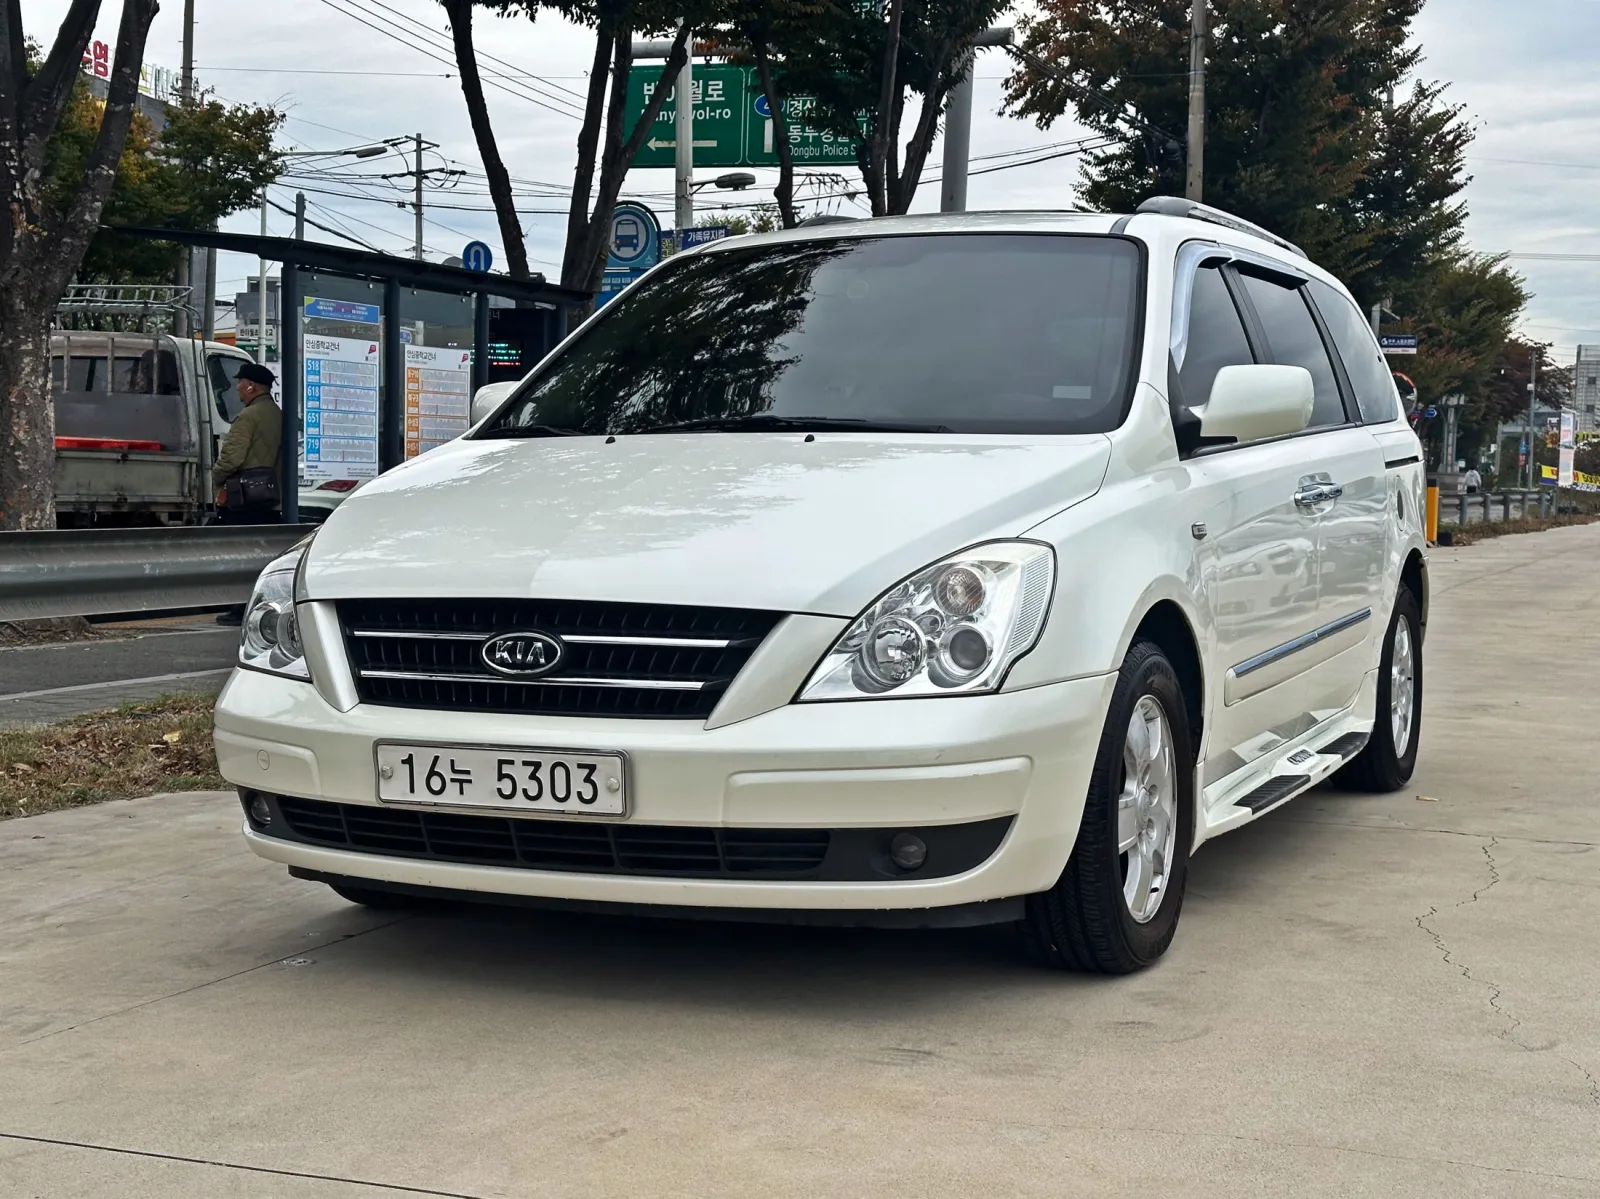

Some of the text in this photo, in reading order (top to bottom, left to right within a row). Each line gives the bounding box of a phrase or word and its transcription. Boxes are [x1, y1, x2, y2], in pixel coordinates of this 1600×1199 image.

[822, 144, 849, 156] Police
[307, 360, 319, 371] 518
[307, 385, 319, 397] 618
[307, 412, 319, 424] 651
[495, 641, 546, 663] KIA
[401, 753, 599, 804] 16누 5303
